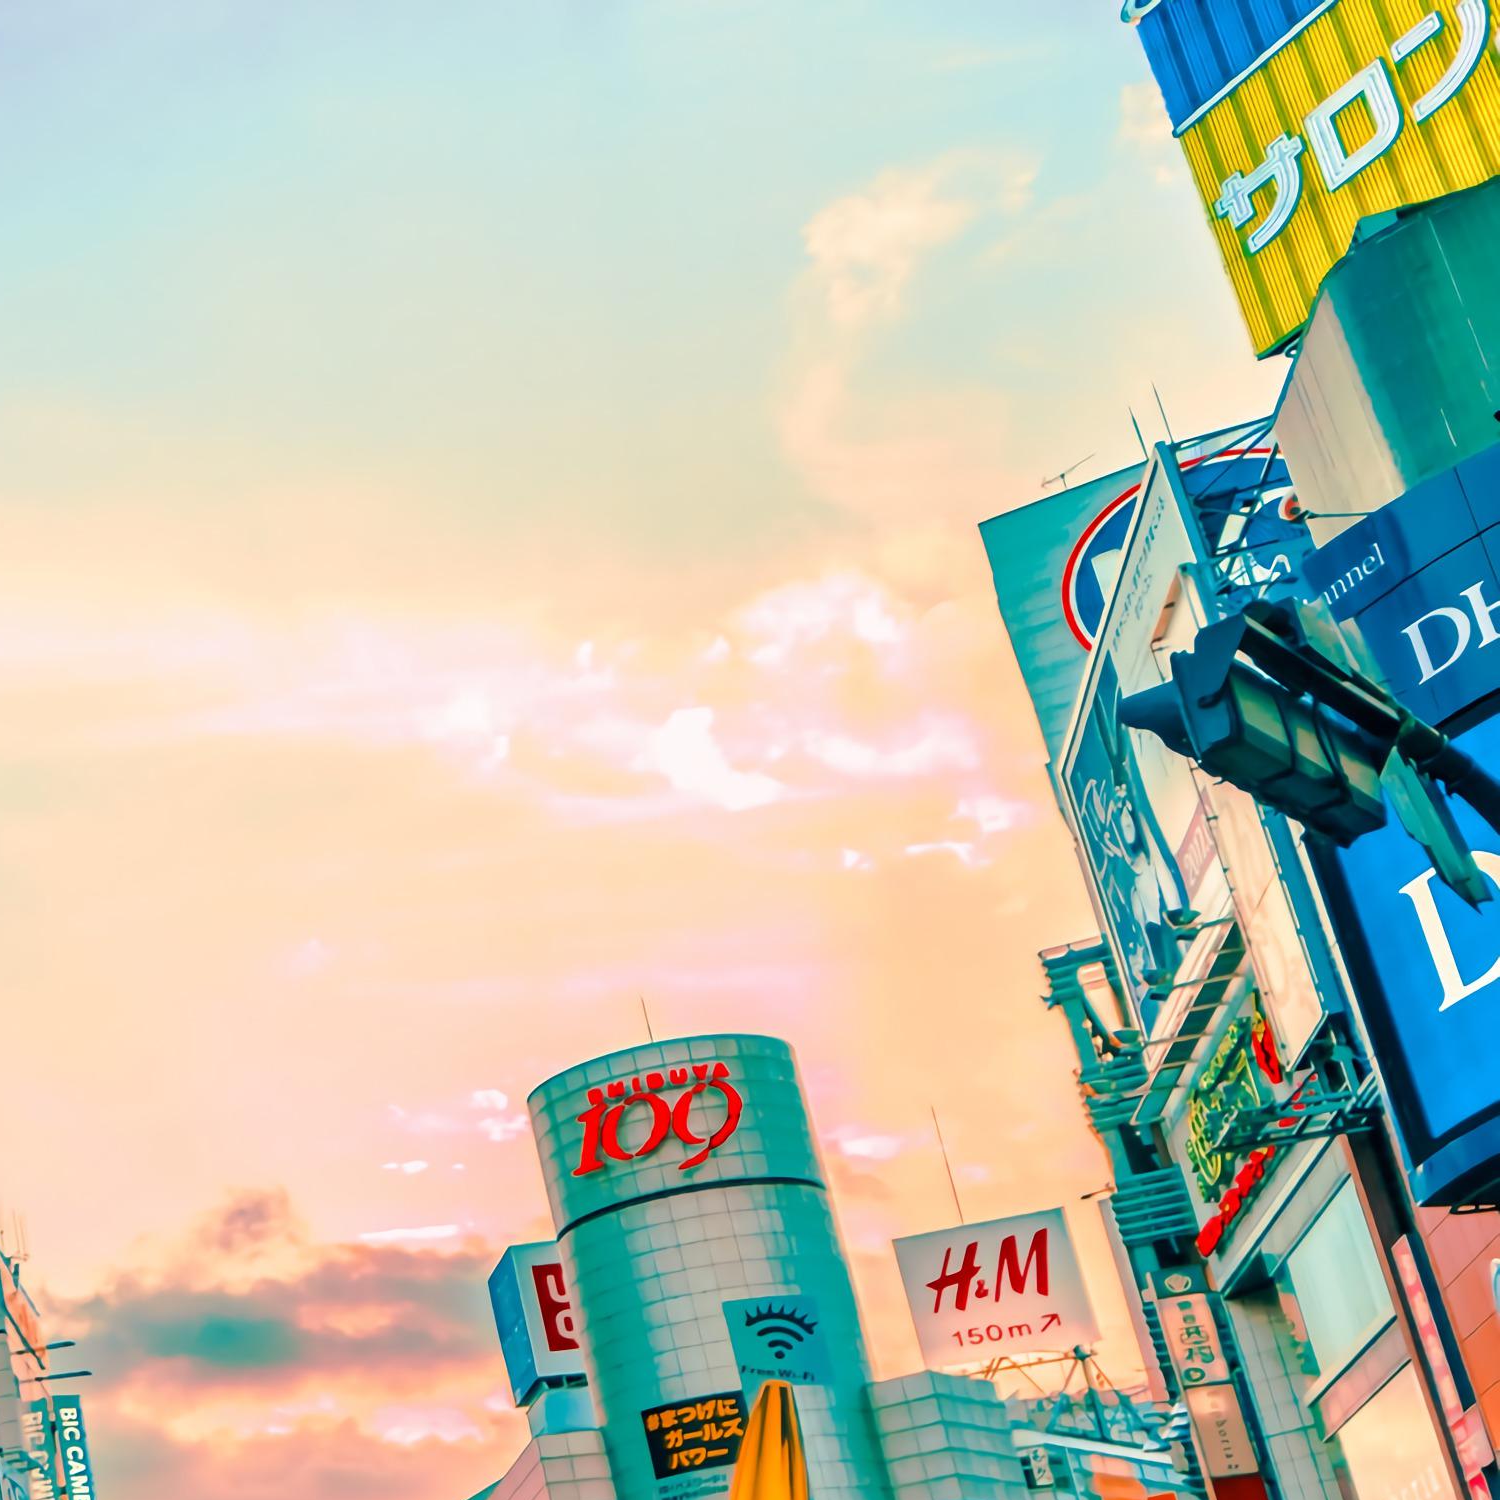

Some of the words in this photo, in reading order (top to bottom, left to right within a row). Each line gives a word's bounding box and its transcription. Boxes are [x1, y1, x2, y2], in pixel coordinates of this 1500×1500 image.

[571, 1079, 743, 1177] 109
[925, 1228, 1049, 1314] H&M
[59, 1407, 81, 1441] BIC
